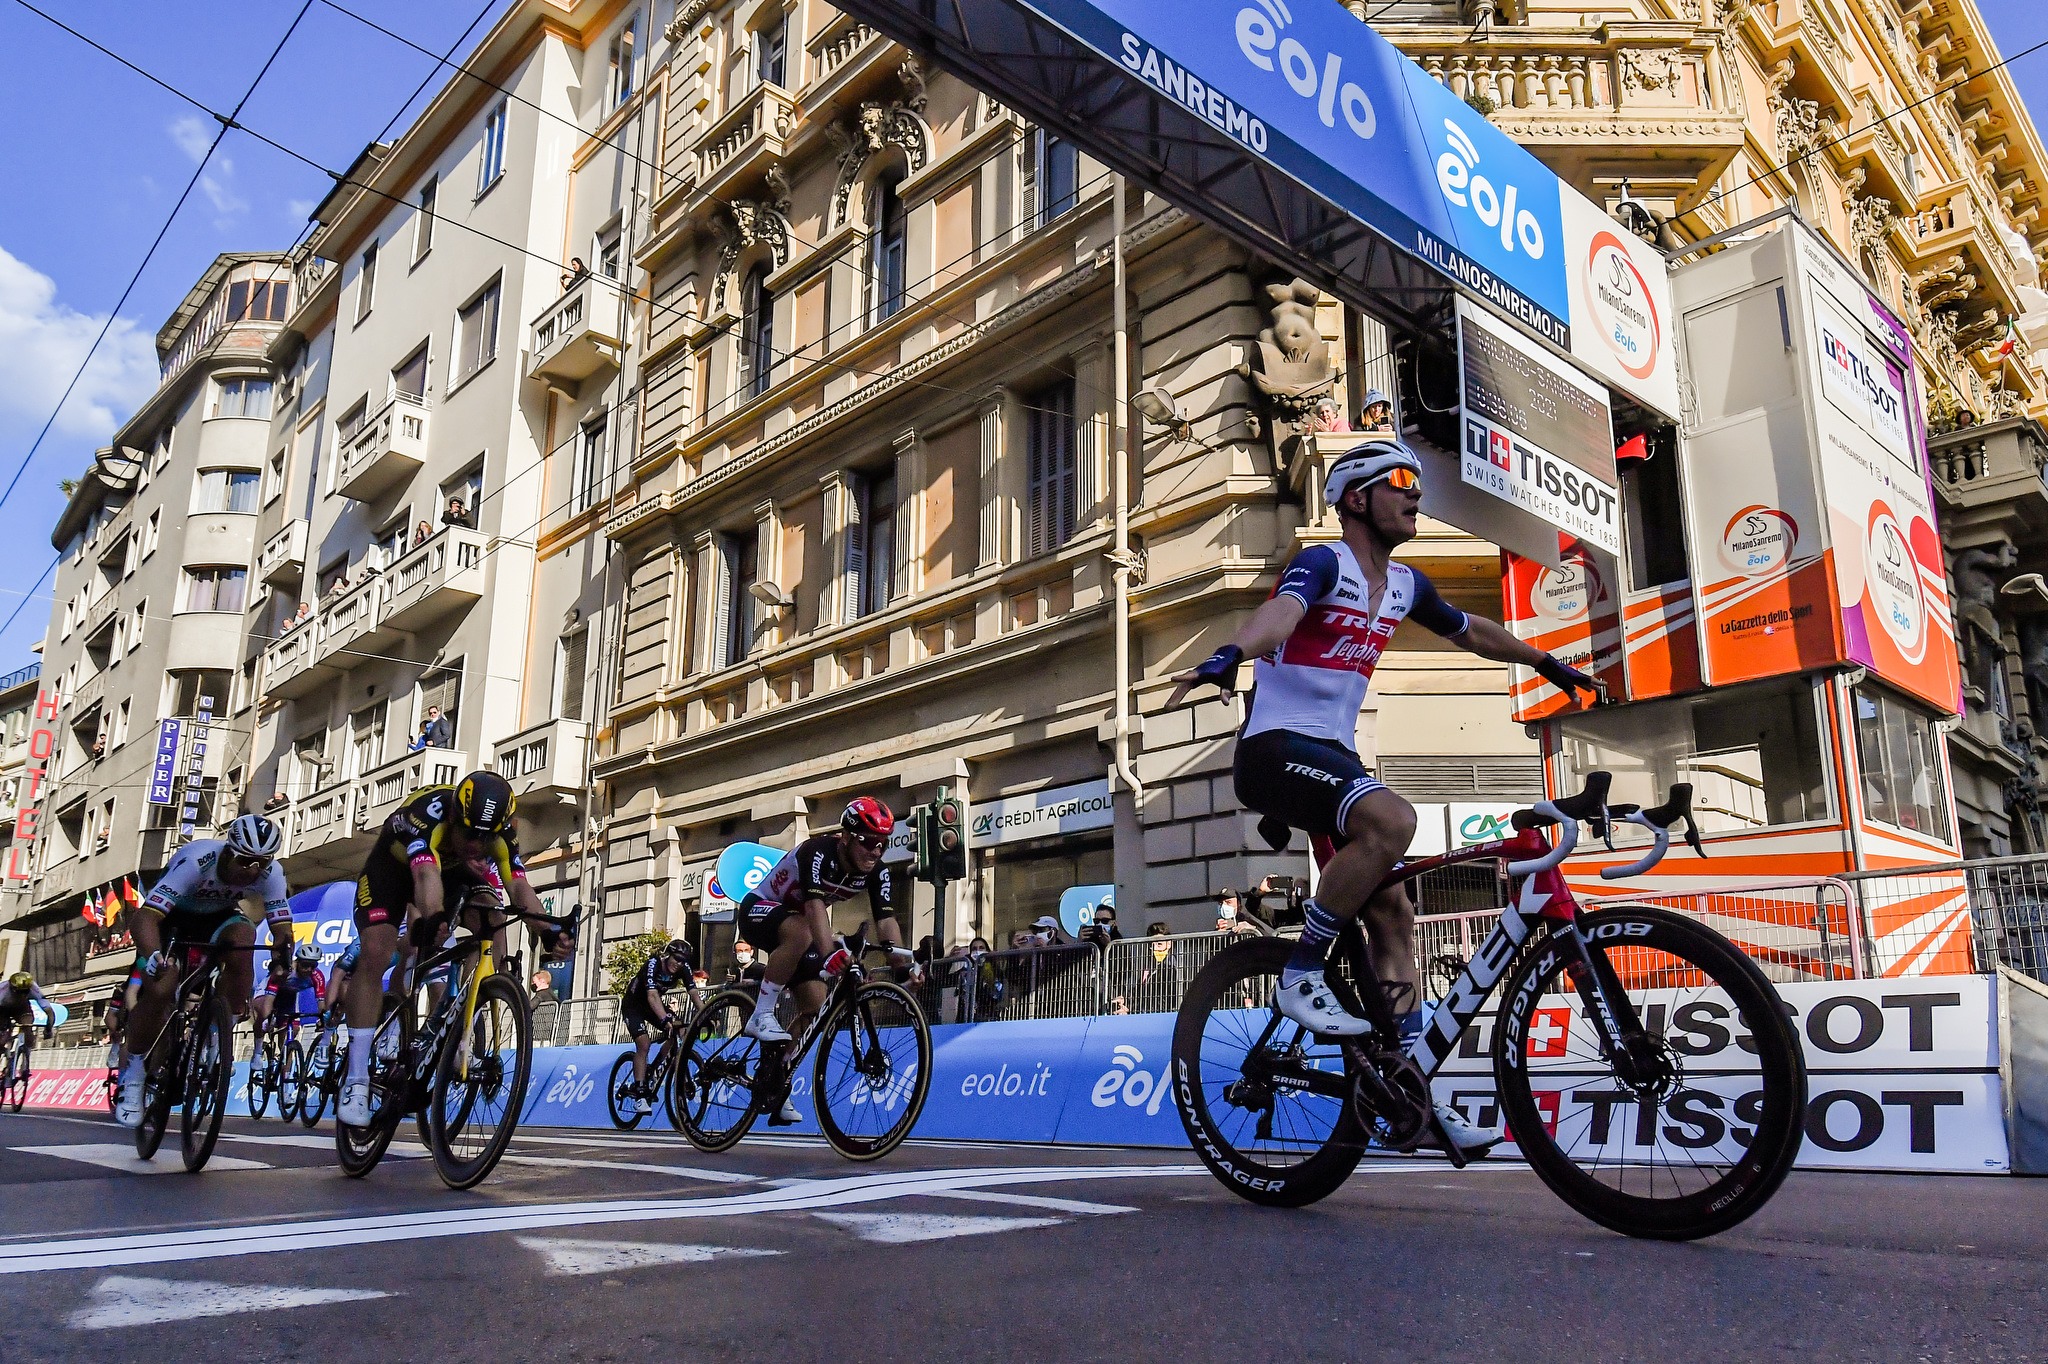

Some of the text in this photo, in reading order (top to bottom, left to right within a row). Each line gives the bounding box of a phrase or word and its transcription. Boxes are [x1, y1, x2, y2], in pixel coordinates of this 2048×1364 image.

[1120, 32, 1268, 153] SANREMO
[1235, 8, 1376, 139] eolo
[1436, 152, 1544, 260] eolo
[1417, 231, 1567, 347] MILANOSANREMO.IT
[1614, 329, 1637, 353] eolo
[1847, 351, 1898, 421] TISSOT
[1876, 411, 1891, 431] INCE
[1466, 462, 1619, 549] SWISS WATCHES SINCE 1853
[1513, 443, 1616, 524] TISSOT
[1732, 533, 1782, 552] MilanoSanremo
[1747, 554, 1771, 566] eolo
[154, 721, 177, 798] PIPER
[1284, 762, 1343, 786] TREK
[9, 690, 59, 880] HOTEL
[481, 798, 497, 822] WOUT
[995, 808, 1044, 829] CRÉDIT
[1047, 797, 1115, 820] AGRICOL
[198, 851, 216, 866] BORA
[317, 919, 358, 945] GL
[1406, 868, 1553, 1076] TREK
[1595, 986, 1625, 1051] TREK
[546, 1073, 595, 1108] eolo
[961, 1062, 1052, 1096] eolo.it
[1091, 1060, 1178, 1116] eol
[1272, 1075, 1310, 1088] SRAM
[1176, 1057, 1285, 1194] BONTRAGER
[1711, 1184, 1744, 1212] AEOLUS
